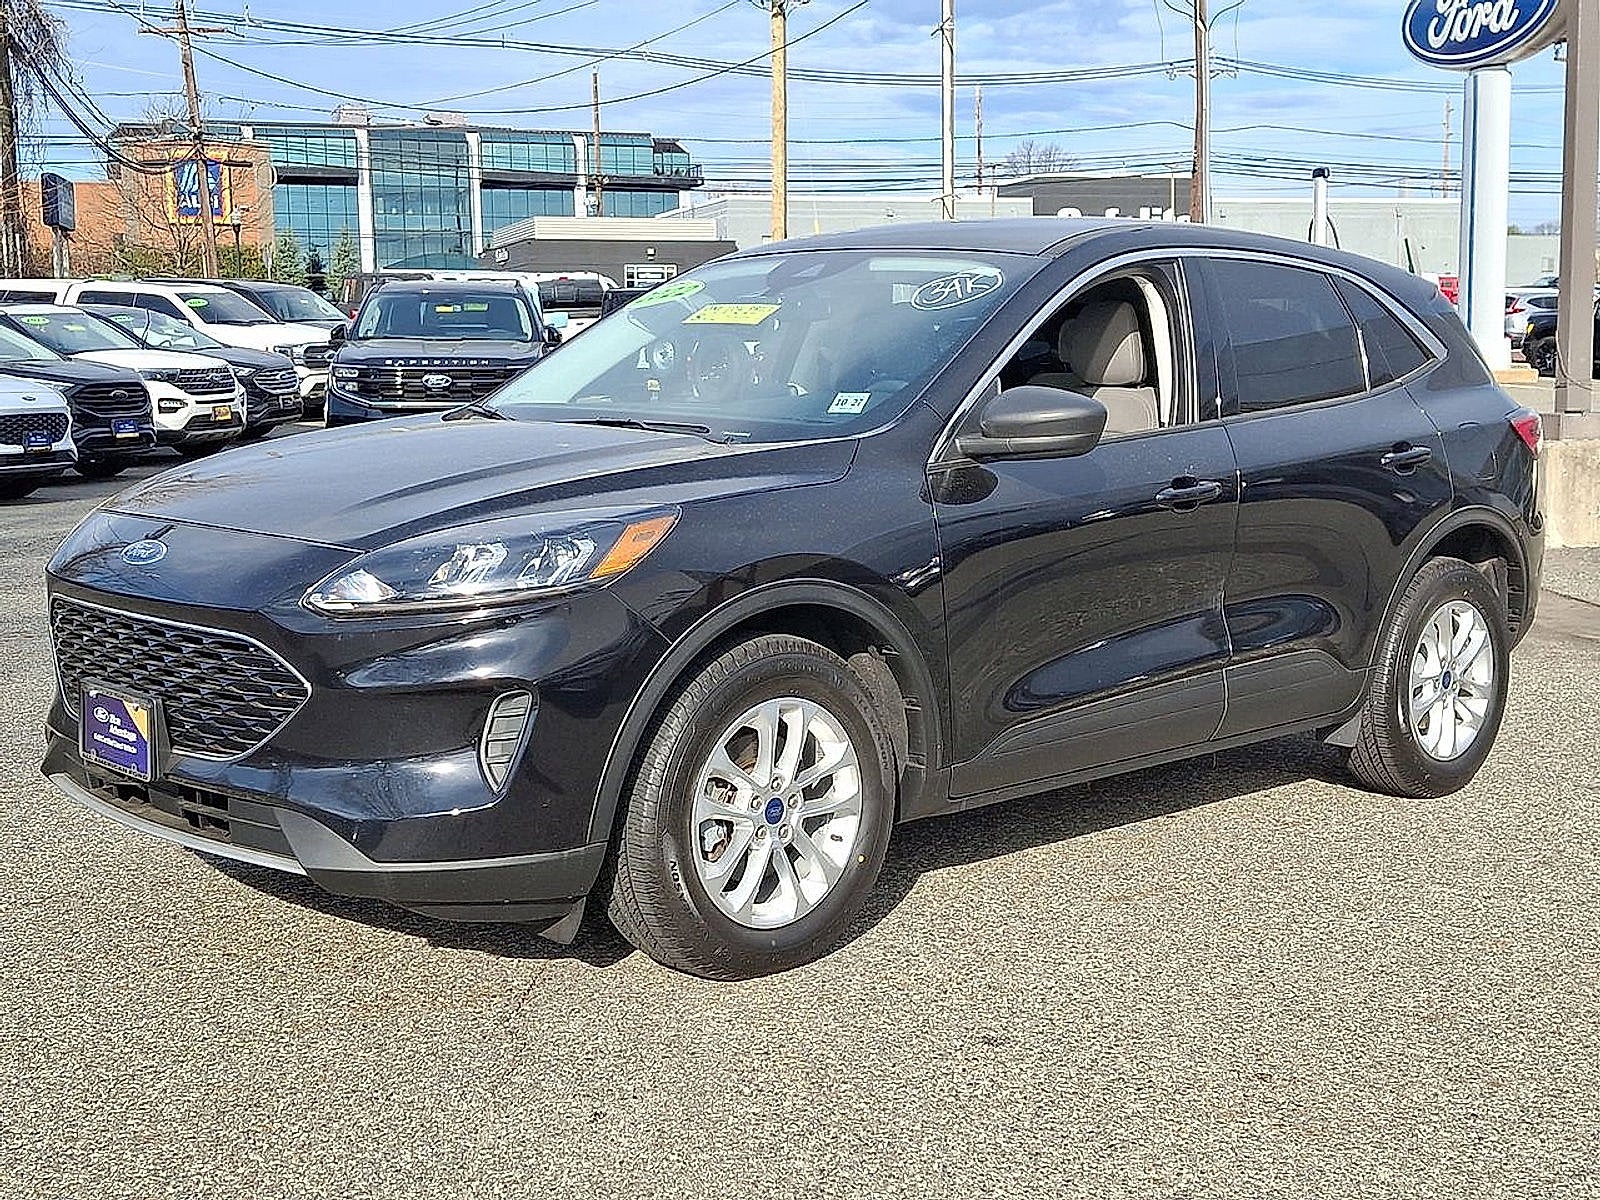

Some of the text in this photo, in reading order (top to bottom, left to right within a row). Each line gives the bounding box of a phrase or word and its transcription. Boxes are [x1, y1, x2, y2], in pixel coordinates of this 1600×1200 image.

[1428, 0, 1520, 49] Ford
[179, 194, 219, 208] ALI
[384, 359, 489, 367] EXPEDITION
[835, 398, 864, 406] 10 27
